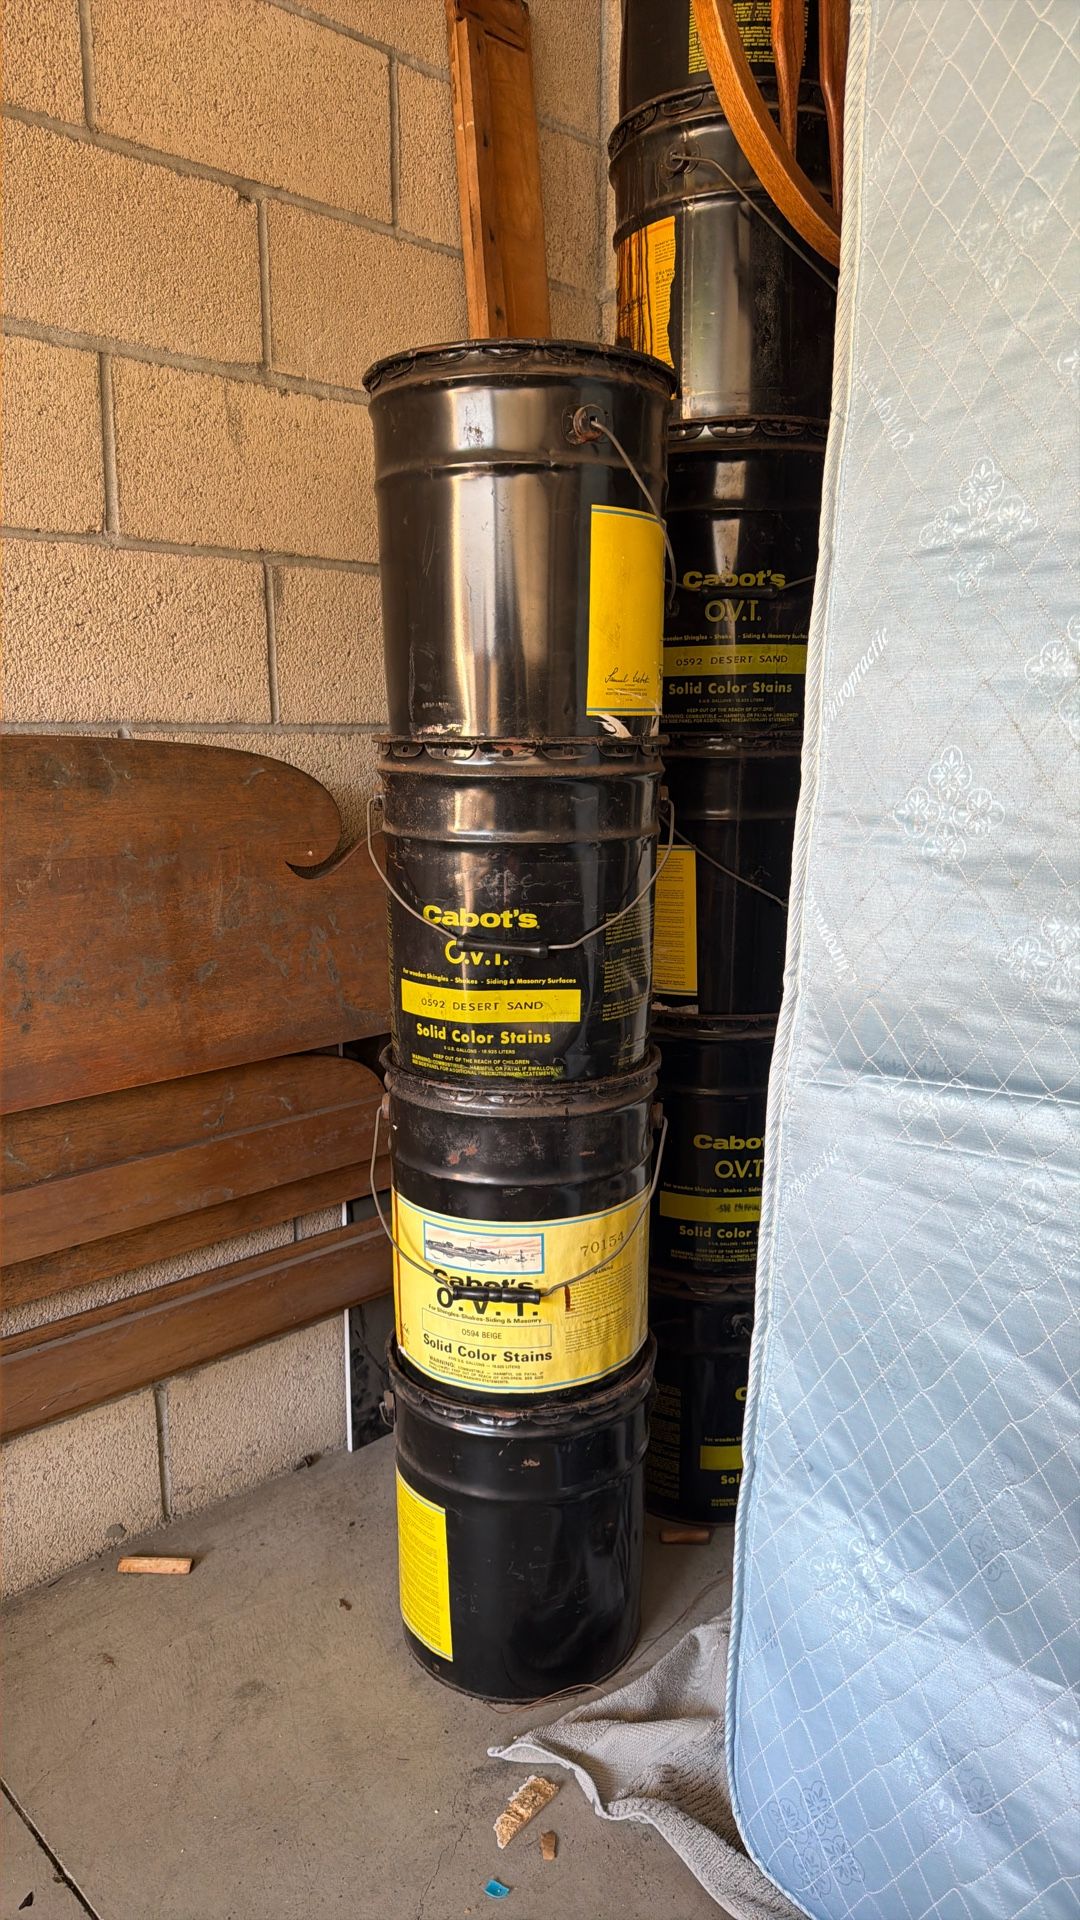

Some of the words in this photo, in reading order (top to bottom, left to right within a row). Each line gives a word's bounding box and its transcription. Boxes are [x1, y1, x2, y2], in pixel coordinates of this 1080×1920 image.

[682, 570, 786, 592] Cabot's
[704, 600, 762, 623] O.V.T.
[675, 657, 703, 667] 0592
[710, 655, 753, 665] DESERT
[759, 654, 788, 663] SAND
[668, 681, 702, 695] Solid
[707, 680, 747, 694] Color
[752, 680, 792, 694] Stains
[422, 904, 538, 929] Cabot's
[427, 972, 448, 983] Shingles
[454, 976, 478, 984] Shakes
[486, 978, 508, 986] Siding
[516, 978, 546, 986] Masonry
[547, 976, 577, 985] Surfaces
[421, 997, 446, 1009] 0592
[452, 1001, 500, 1012] DESERT
[507, 1001, 544, 1011] SAND
[416, 1022, 446, 1040] Solid
[451, 1029, 494, 1044] Color
[500, 1029, 552, 1045] Stains
[693, 1134, 765, 1150] Cabo
[679, 1225, 712, 1238] Solid
[716, 1227, 752, 1239] Color
[580, 1231, 625, 1257] 70154
[428, 1303, 437, 1311] For
[461, 1328, 480, 1337] 0594
[481, 1331, 503, 1340] BEIGE
[423, 1333, 452, 1354] Solid
[457, 1345, 497, 1361] Color
[503, 1351, 553, 1363] Stains
